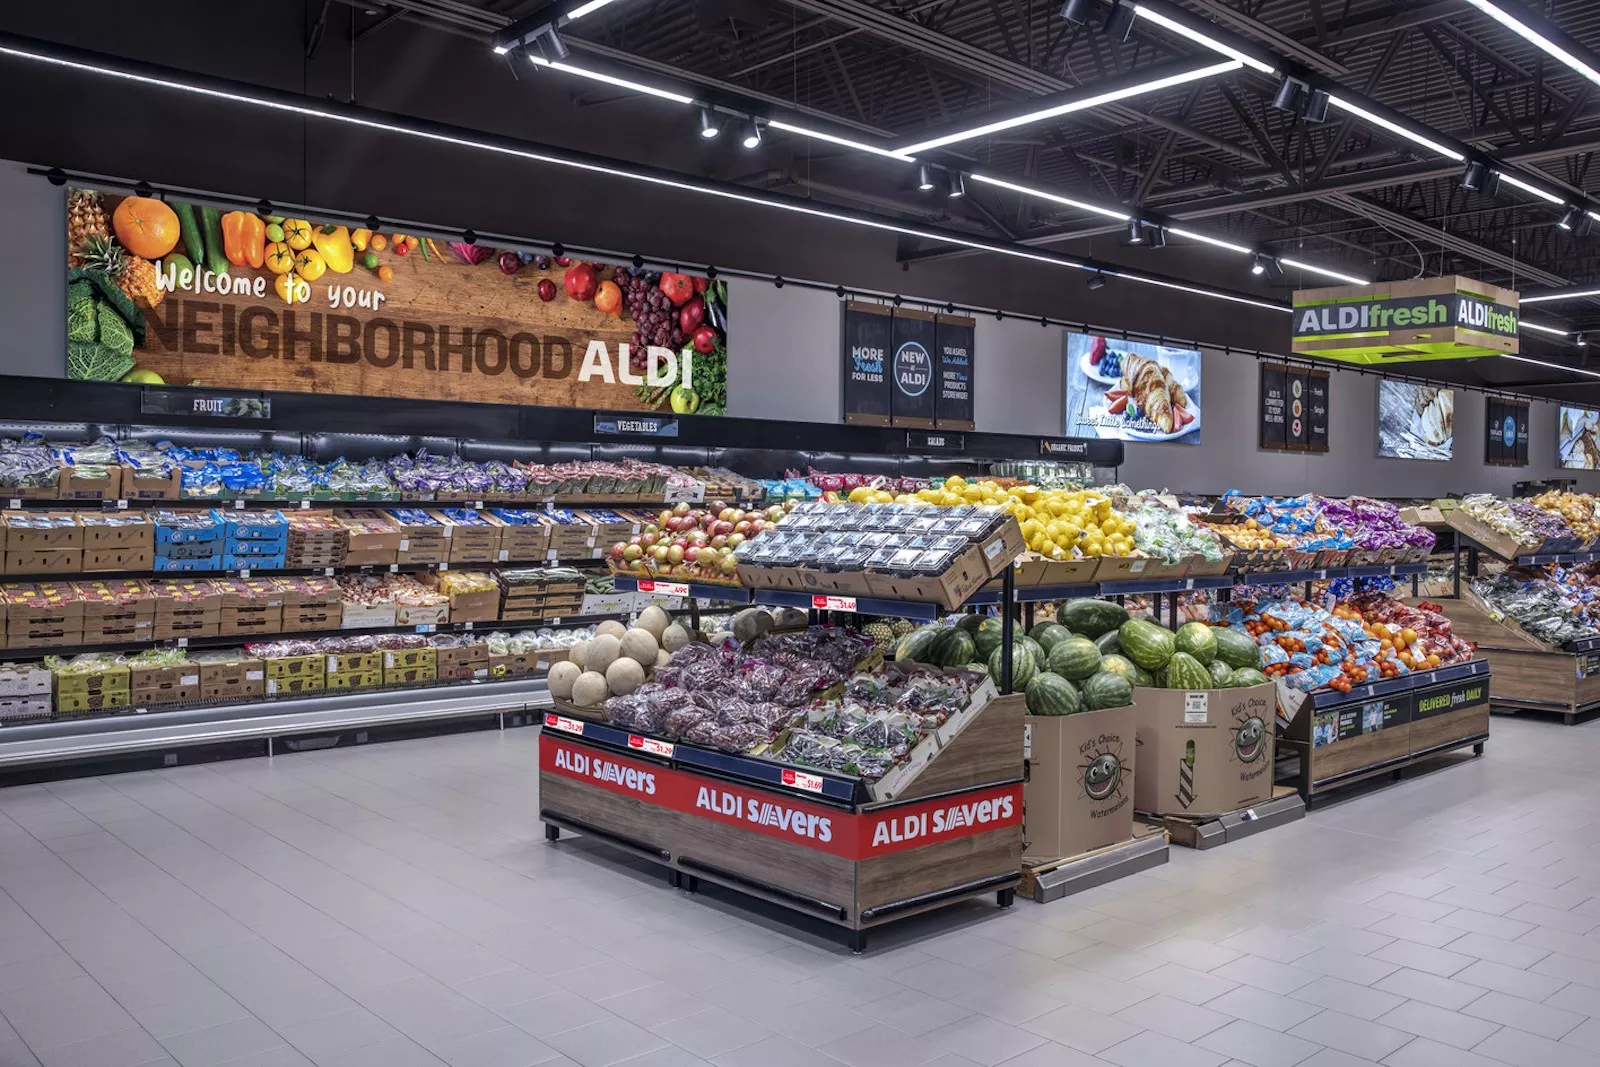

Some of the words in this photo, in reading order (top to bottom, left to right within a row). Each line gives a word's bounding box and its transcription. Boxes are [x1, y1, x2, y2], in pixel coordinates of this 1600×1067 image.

[155, 260, 266, 298] Welcome
[284, 273, 311, 304] to
[327, 284, 385, 311] your
[144, 299, 573, 379] NEIGHBORHOOD
[577, 340, 692, 389] ALDI
[943, 346, 953, 355] YOU
[852, 346, 884, 361] MORE
[901, 351, 925, 364] NEW
[854, 357, 883, 373] Fresh
[852, 372, 866, 381] FOR
[867, 372, 883, 382] LESS
[900, 372, 926, 385] ALDI
[943, 371, 957, 380] MORE
[944, 381, 966, 390] PRODUCTS
[193, 399, 223, 412] FRUIT
[617, 420, 658, 432] VEGETABLES
[1051, 443, 1067, 452] ORGANIC
[1067, 444, 1083, 452] PRODUCE
[840, 600, 856, 609] $1.49
[1419, 694, 1450, 712] DELIVERED
[1450, 690, 1465, 708] fresh
[1466, 687, 1482, 701] DAILY
[1231, 701, 1246, 716] Kid's
[1248, 697, 1266, 708] Choice
[568, 721, 583, 732] $1.29
[656, 743, 672, 755] $1.29
[1079, 738, 1096, 755] Kid's
[1098, 732, 1120, 744] Choice
[555, 748, 589, 776] ALDI
[1240, 761, 1271, 781] Watermelons
[807, 779, 822, 789] $1.69
[696, 787, 742, 818] ALDI
[1090, 795, 1129, 819] Watermelons
[872, 812, 928, 847] ALDI
